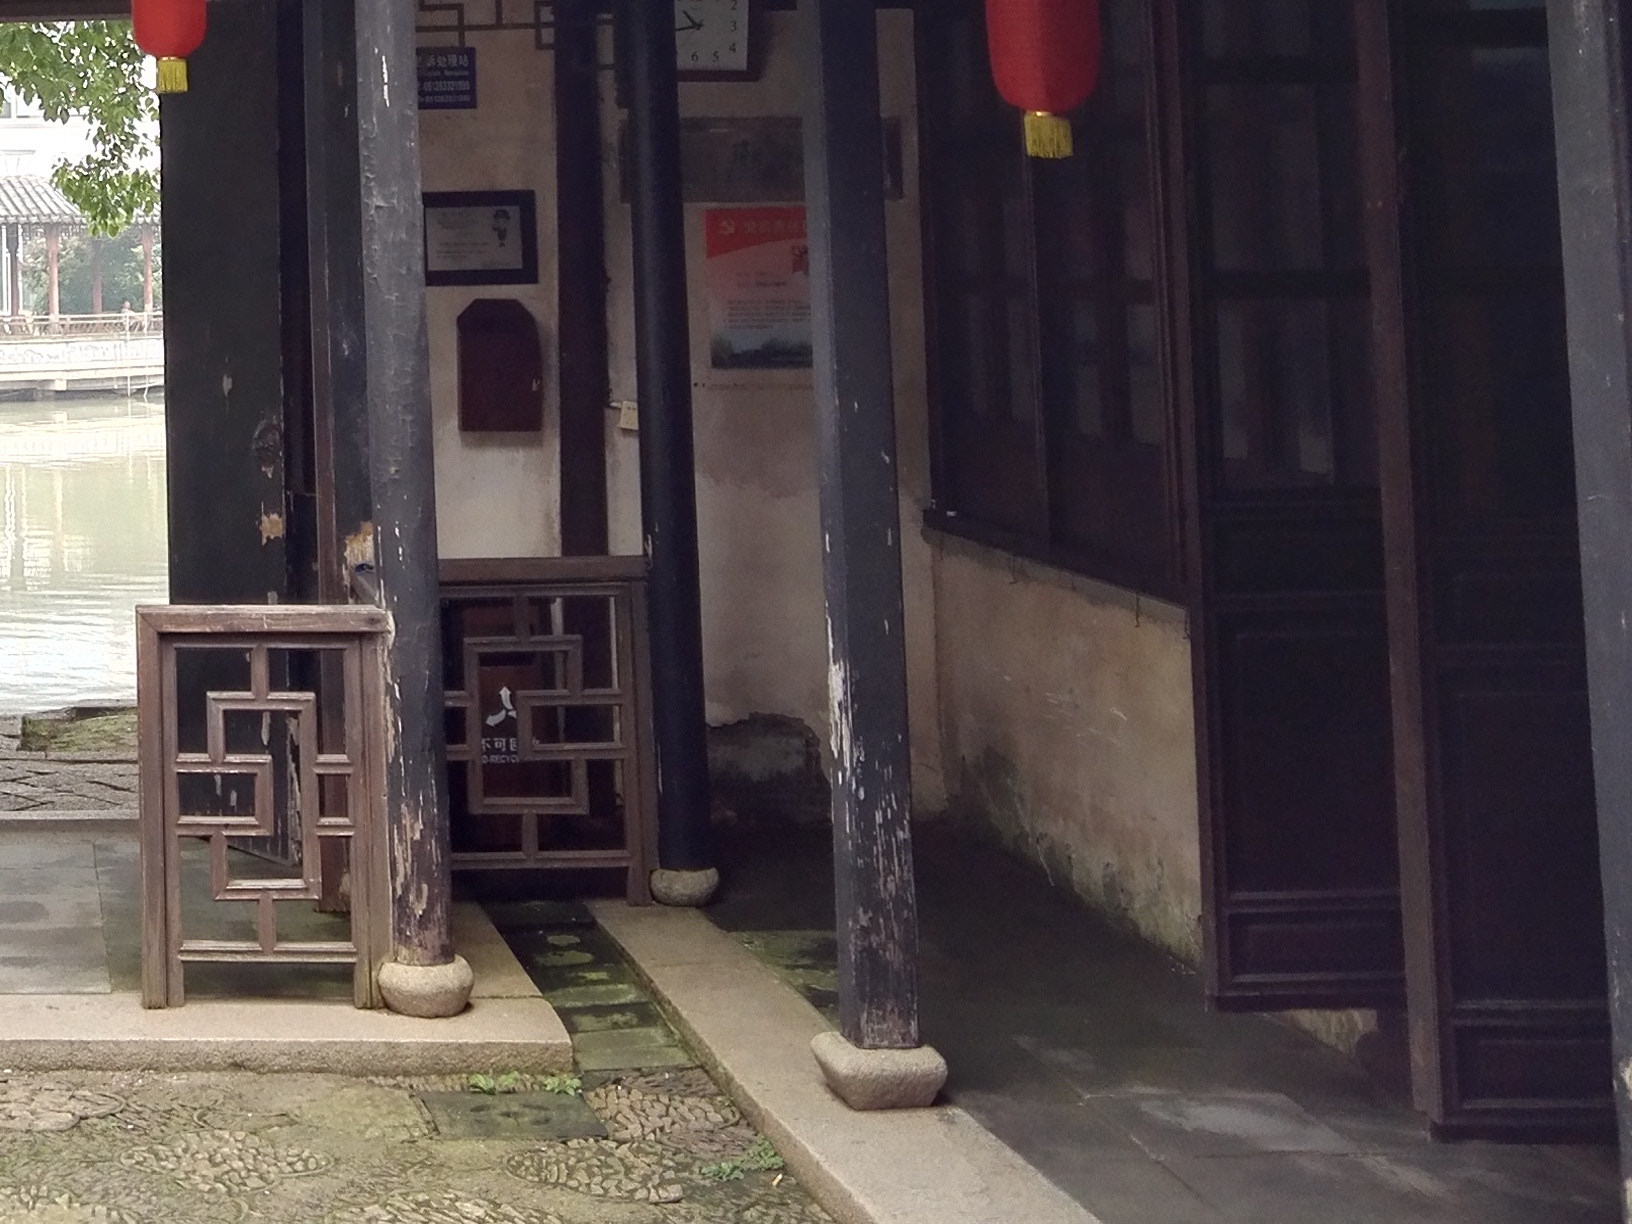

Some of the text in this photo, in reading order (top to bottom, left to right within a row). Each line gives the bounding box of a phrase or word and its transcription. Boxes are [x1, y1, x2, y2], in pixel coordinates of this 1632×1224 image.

[730, 0, 738, 11] 2
[730, 21, 737, 32] 3
[729, 42, 737, 53] 4
[691, 51, 699, 62] 6
[712, 51, 719, 63] 5
